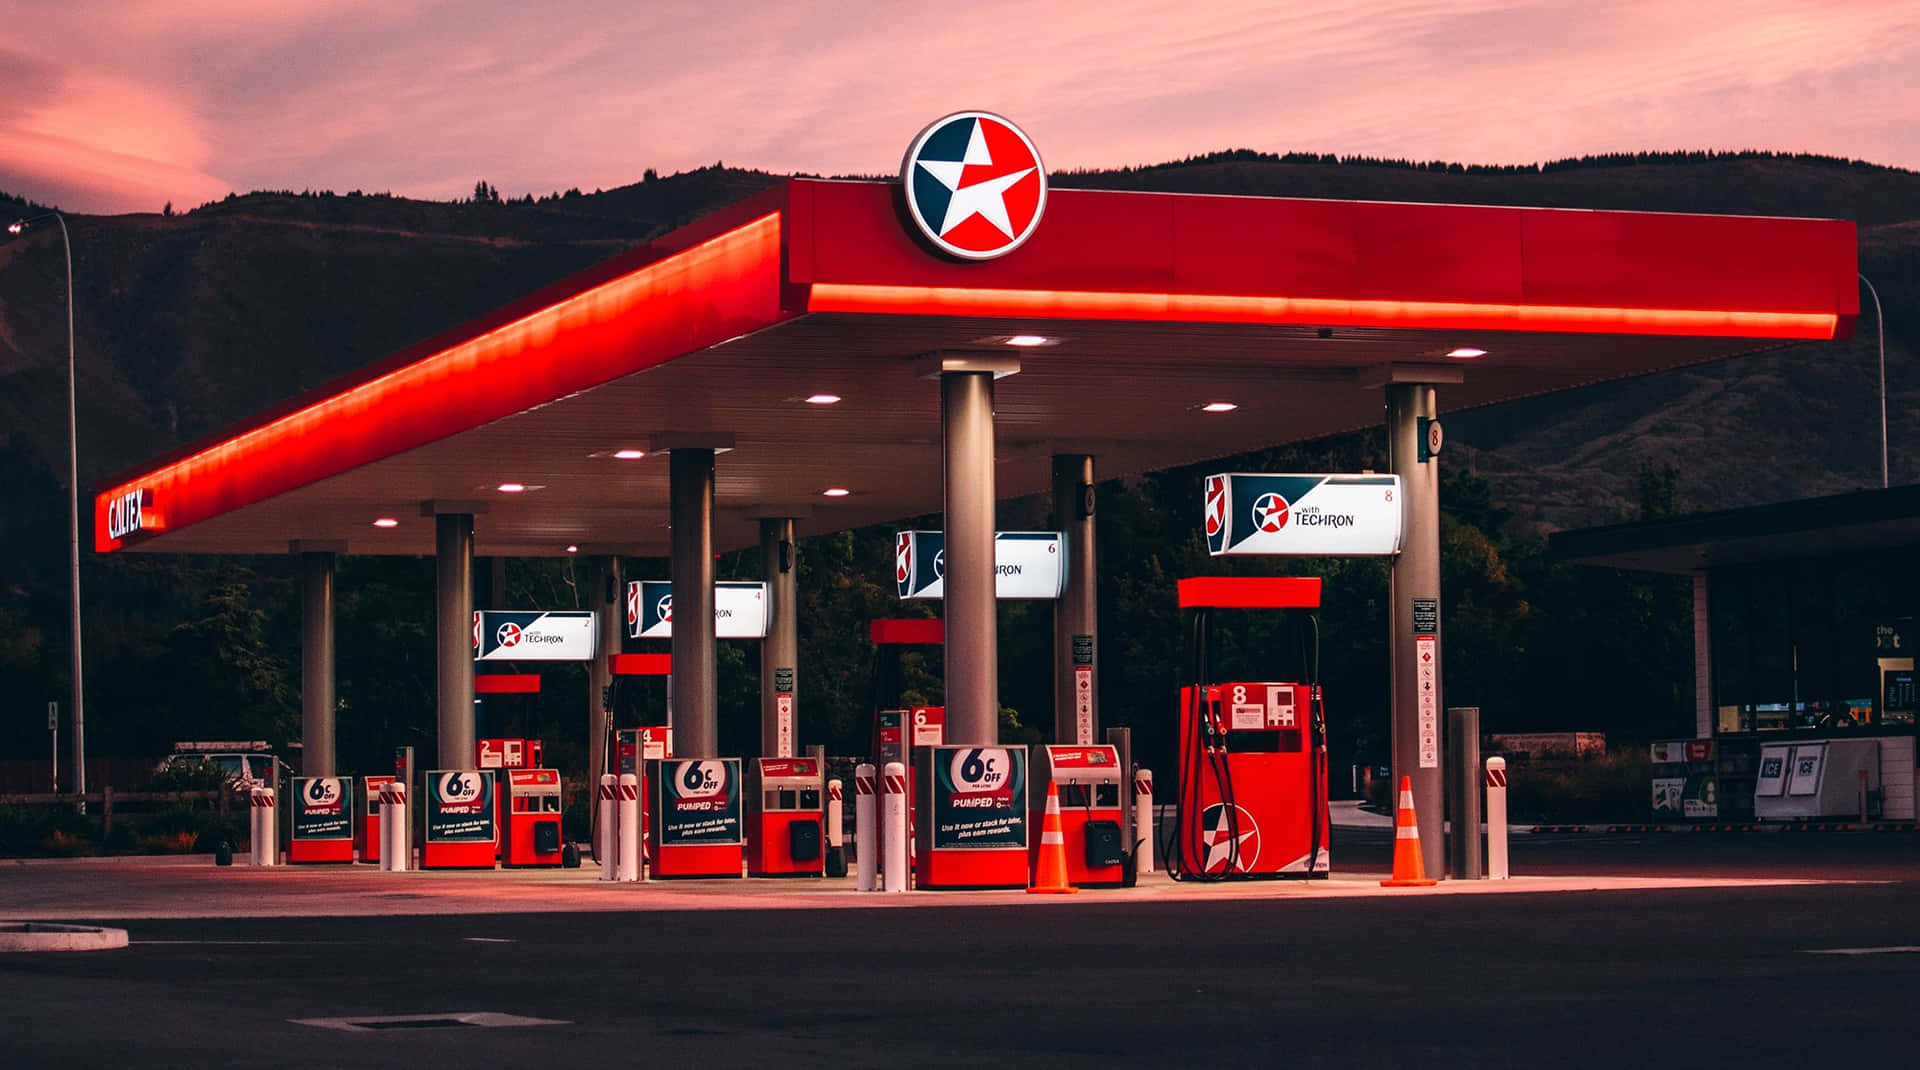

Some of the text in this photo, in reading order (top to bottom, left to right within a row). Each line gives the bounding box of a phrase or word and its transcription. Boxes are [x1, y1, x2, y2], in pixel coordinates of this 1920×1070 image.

[1432, 430, 1438, 446] 8
[1384, 490, 1393, 502] 8
[108, 488, 143, 539] CALTEX
[1301, 505, 1320, 513] with
[1294, 512, 1354, 528] TECHRON
[1048, 543, 1056, 554] 6
[524, 634, 564, 644] TECHRON
[1232, 685, 1247, 704] 8
[915, 709, 927, 725] 6
[643, 729, 652, 742] 4
[481, 741, 490, 752] 2
[1765, 761, 1780, 776] ICE
[1799, 761, 1814, 776] ICE
[984, 773, 1001, 782] OFF
[703, 781, 718, 790] OFF
[677, 801, 711, 811] PUMPED
[953, 797, 993, 808] PUMPED
